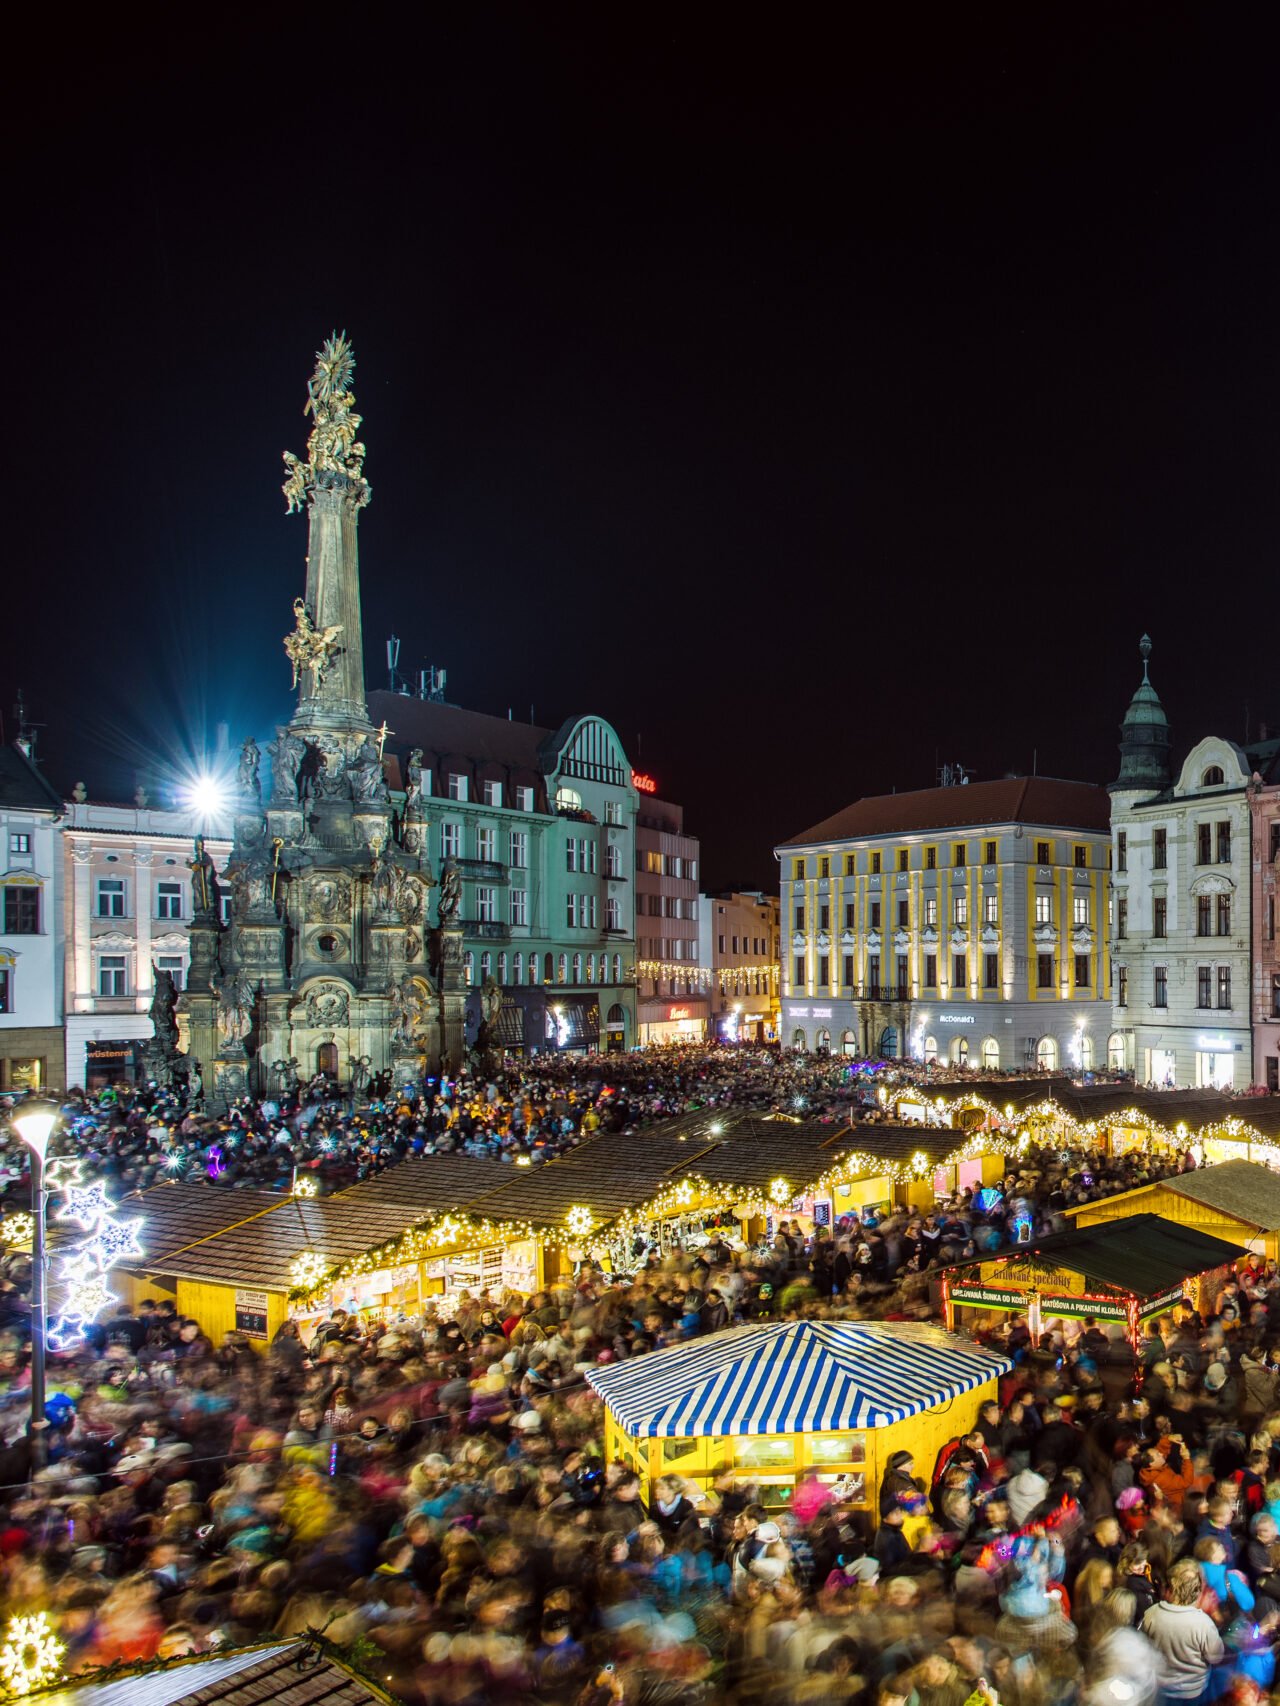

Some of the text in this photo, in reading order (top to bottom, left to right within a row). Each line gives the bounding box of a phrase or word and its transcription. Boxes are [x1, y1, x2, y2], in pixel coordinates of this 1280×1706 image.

[939, 1015, 975, 1024] McDonald's
[88, 1050, 133, 1058] wüstenrot
[983, 1291, 1001, 1302] ŠUNKA
[1002, 1295, 1010, 1303] OD
